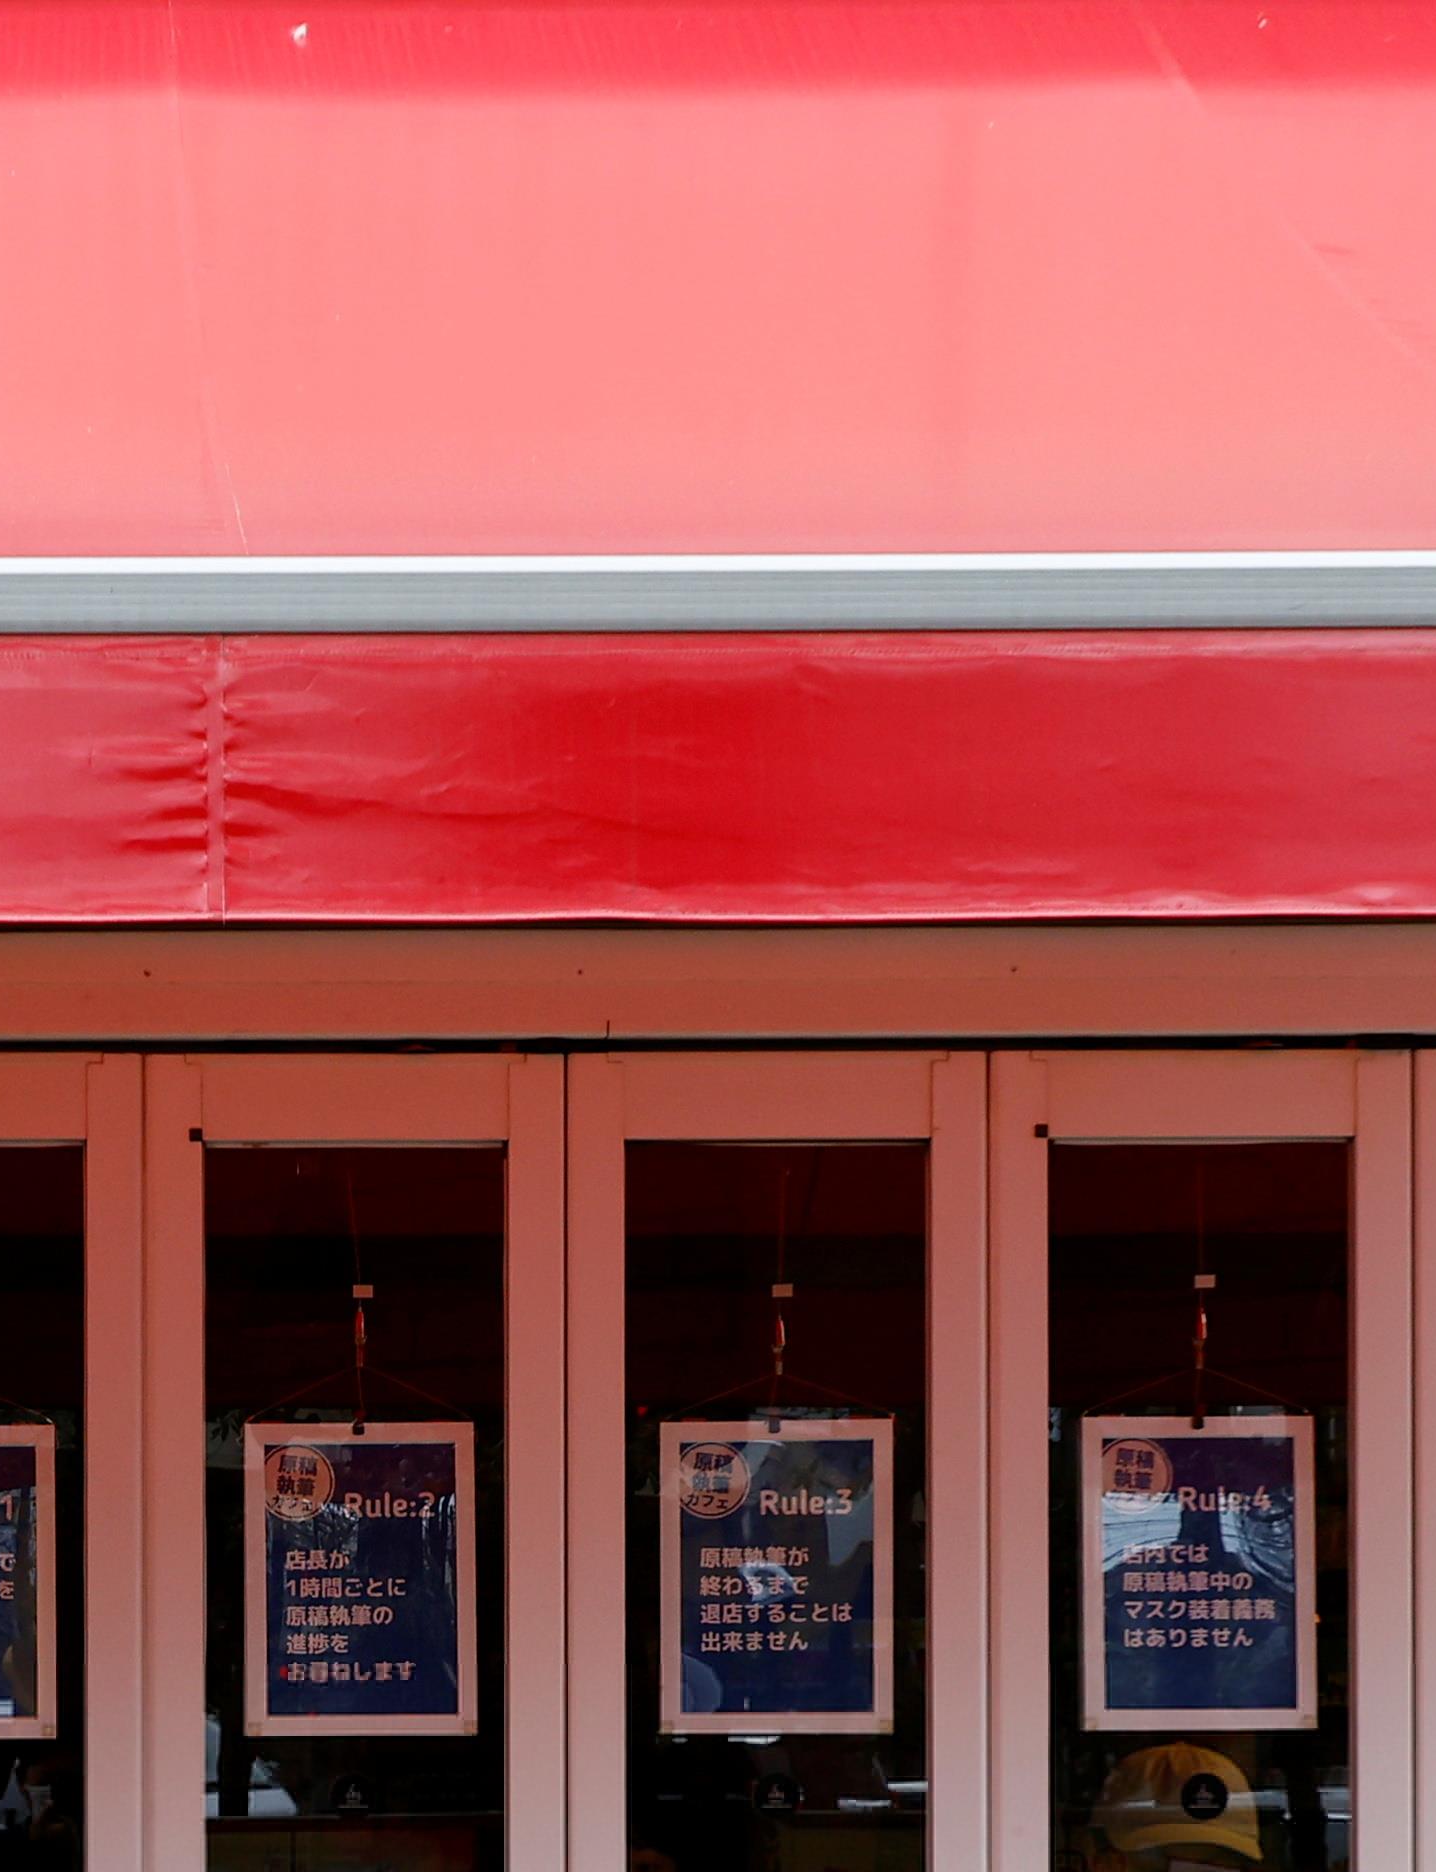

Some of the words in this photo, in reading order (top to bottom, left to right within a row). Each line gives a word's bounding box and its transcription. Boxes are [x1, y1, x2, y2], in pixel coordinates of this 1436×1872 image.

[344, 1492, 436, 1518] Rule:2
[686, 1493, 730, 1509] カフェ
[759, 1488, 853, 1516] Rule:3
[1178, 1485, 1273, 1512] Rule:4
[286, 1550, 350, 1570] 店長が
[700, 1546, 809, 1568] 原稿執筆が
[1123, 1543, 1209, 1564] 店内では
[285, 1578, 407, 1598] 1時間ごとに
[700, 1575, 809, 1596] 終わるまで
[1122, 1571, 1254, 1592] 原稿執筆中の
[286, 1604, 394, 1626] 原稿執筆の
[700, 1603, 853, 1624] 退店することは
[1123, 1599, 1276, 1620] マスク装着義務
[286, 1633, 349, 1654] 進捗を
[700, 1631, 809, 1652] 出来ません
[1123, 1626, 1254, 1648] はありません
